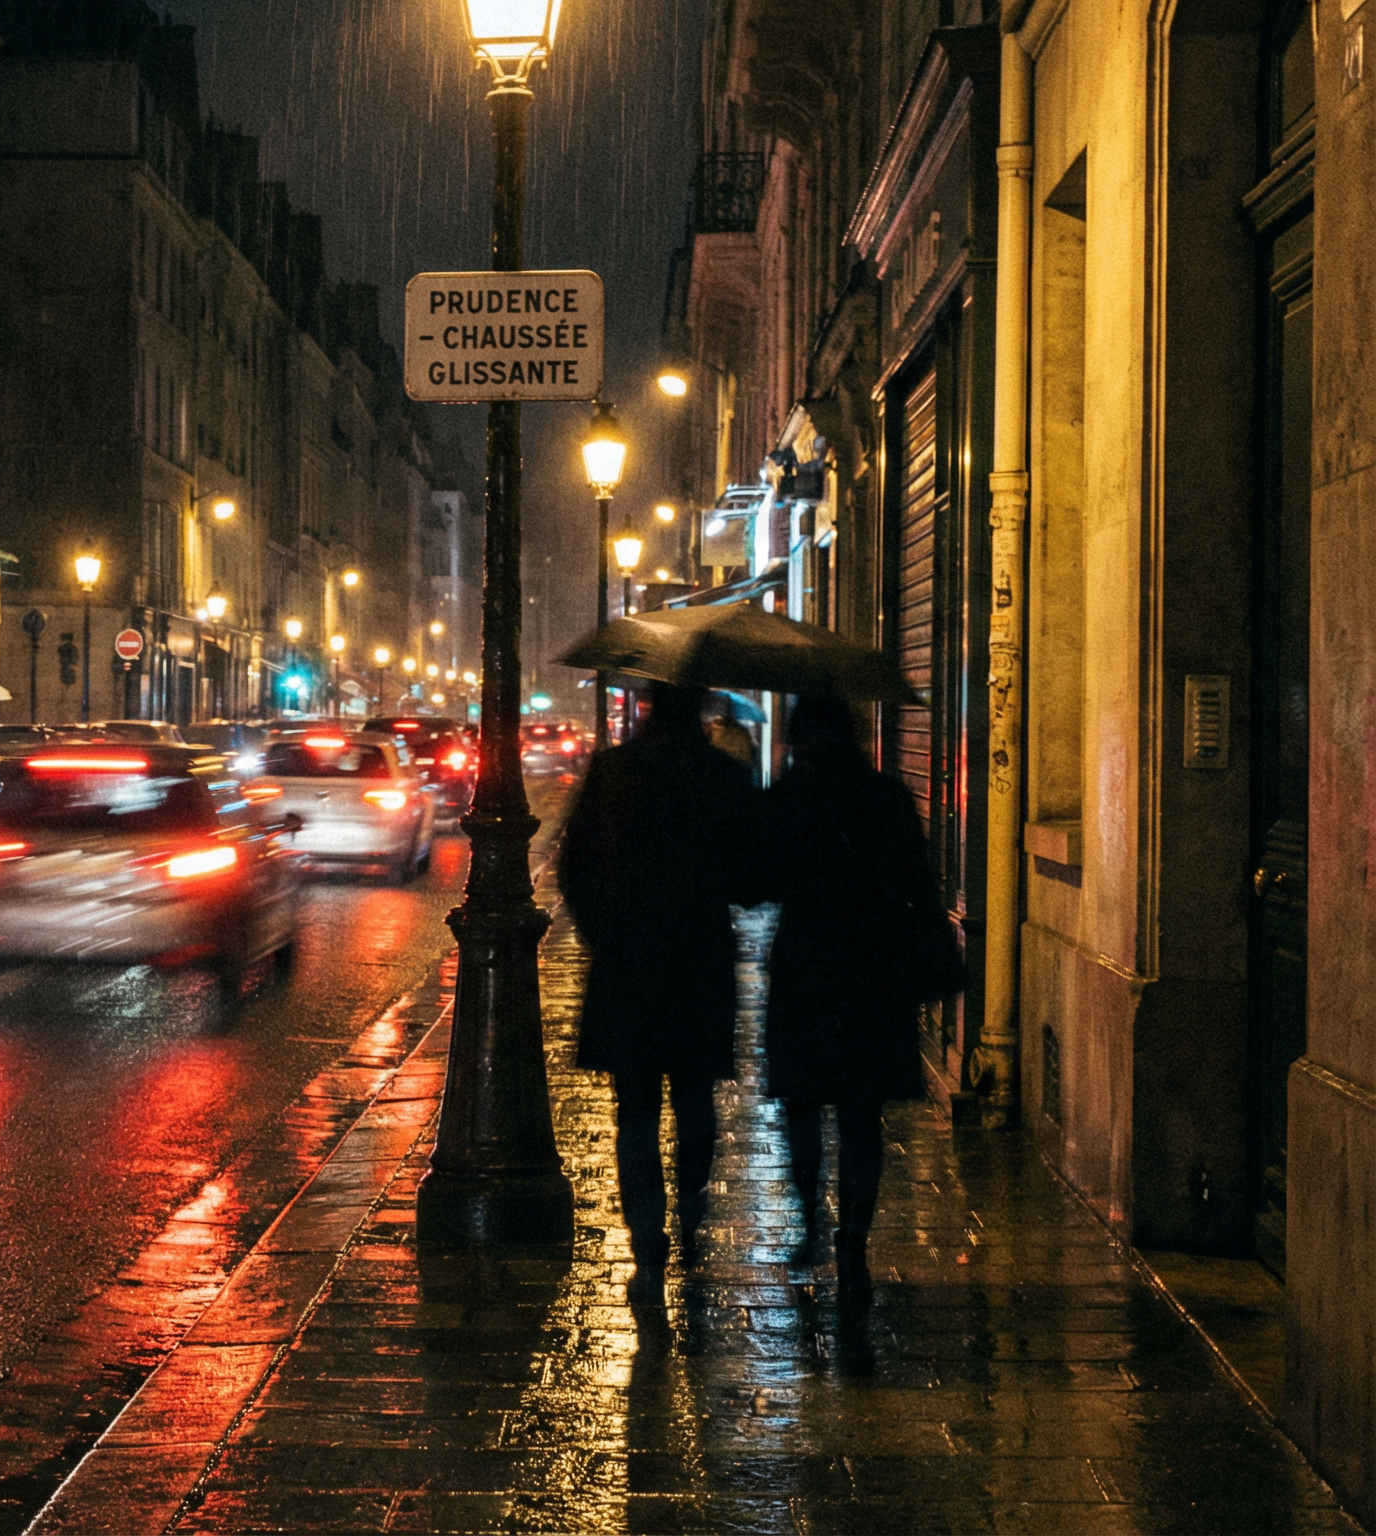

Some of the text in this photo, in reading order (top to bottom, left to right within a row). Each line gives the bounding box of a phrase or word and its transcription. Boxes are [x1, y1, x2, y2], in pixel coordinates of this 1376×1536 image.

[430, 289, 578, 314] PRUDENCE
[443, 319, 588, 349] CHAUSSÉE
[428, 360, 578, 385] GLISSANTE
